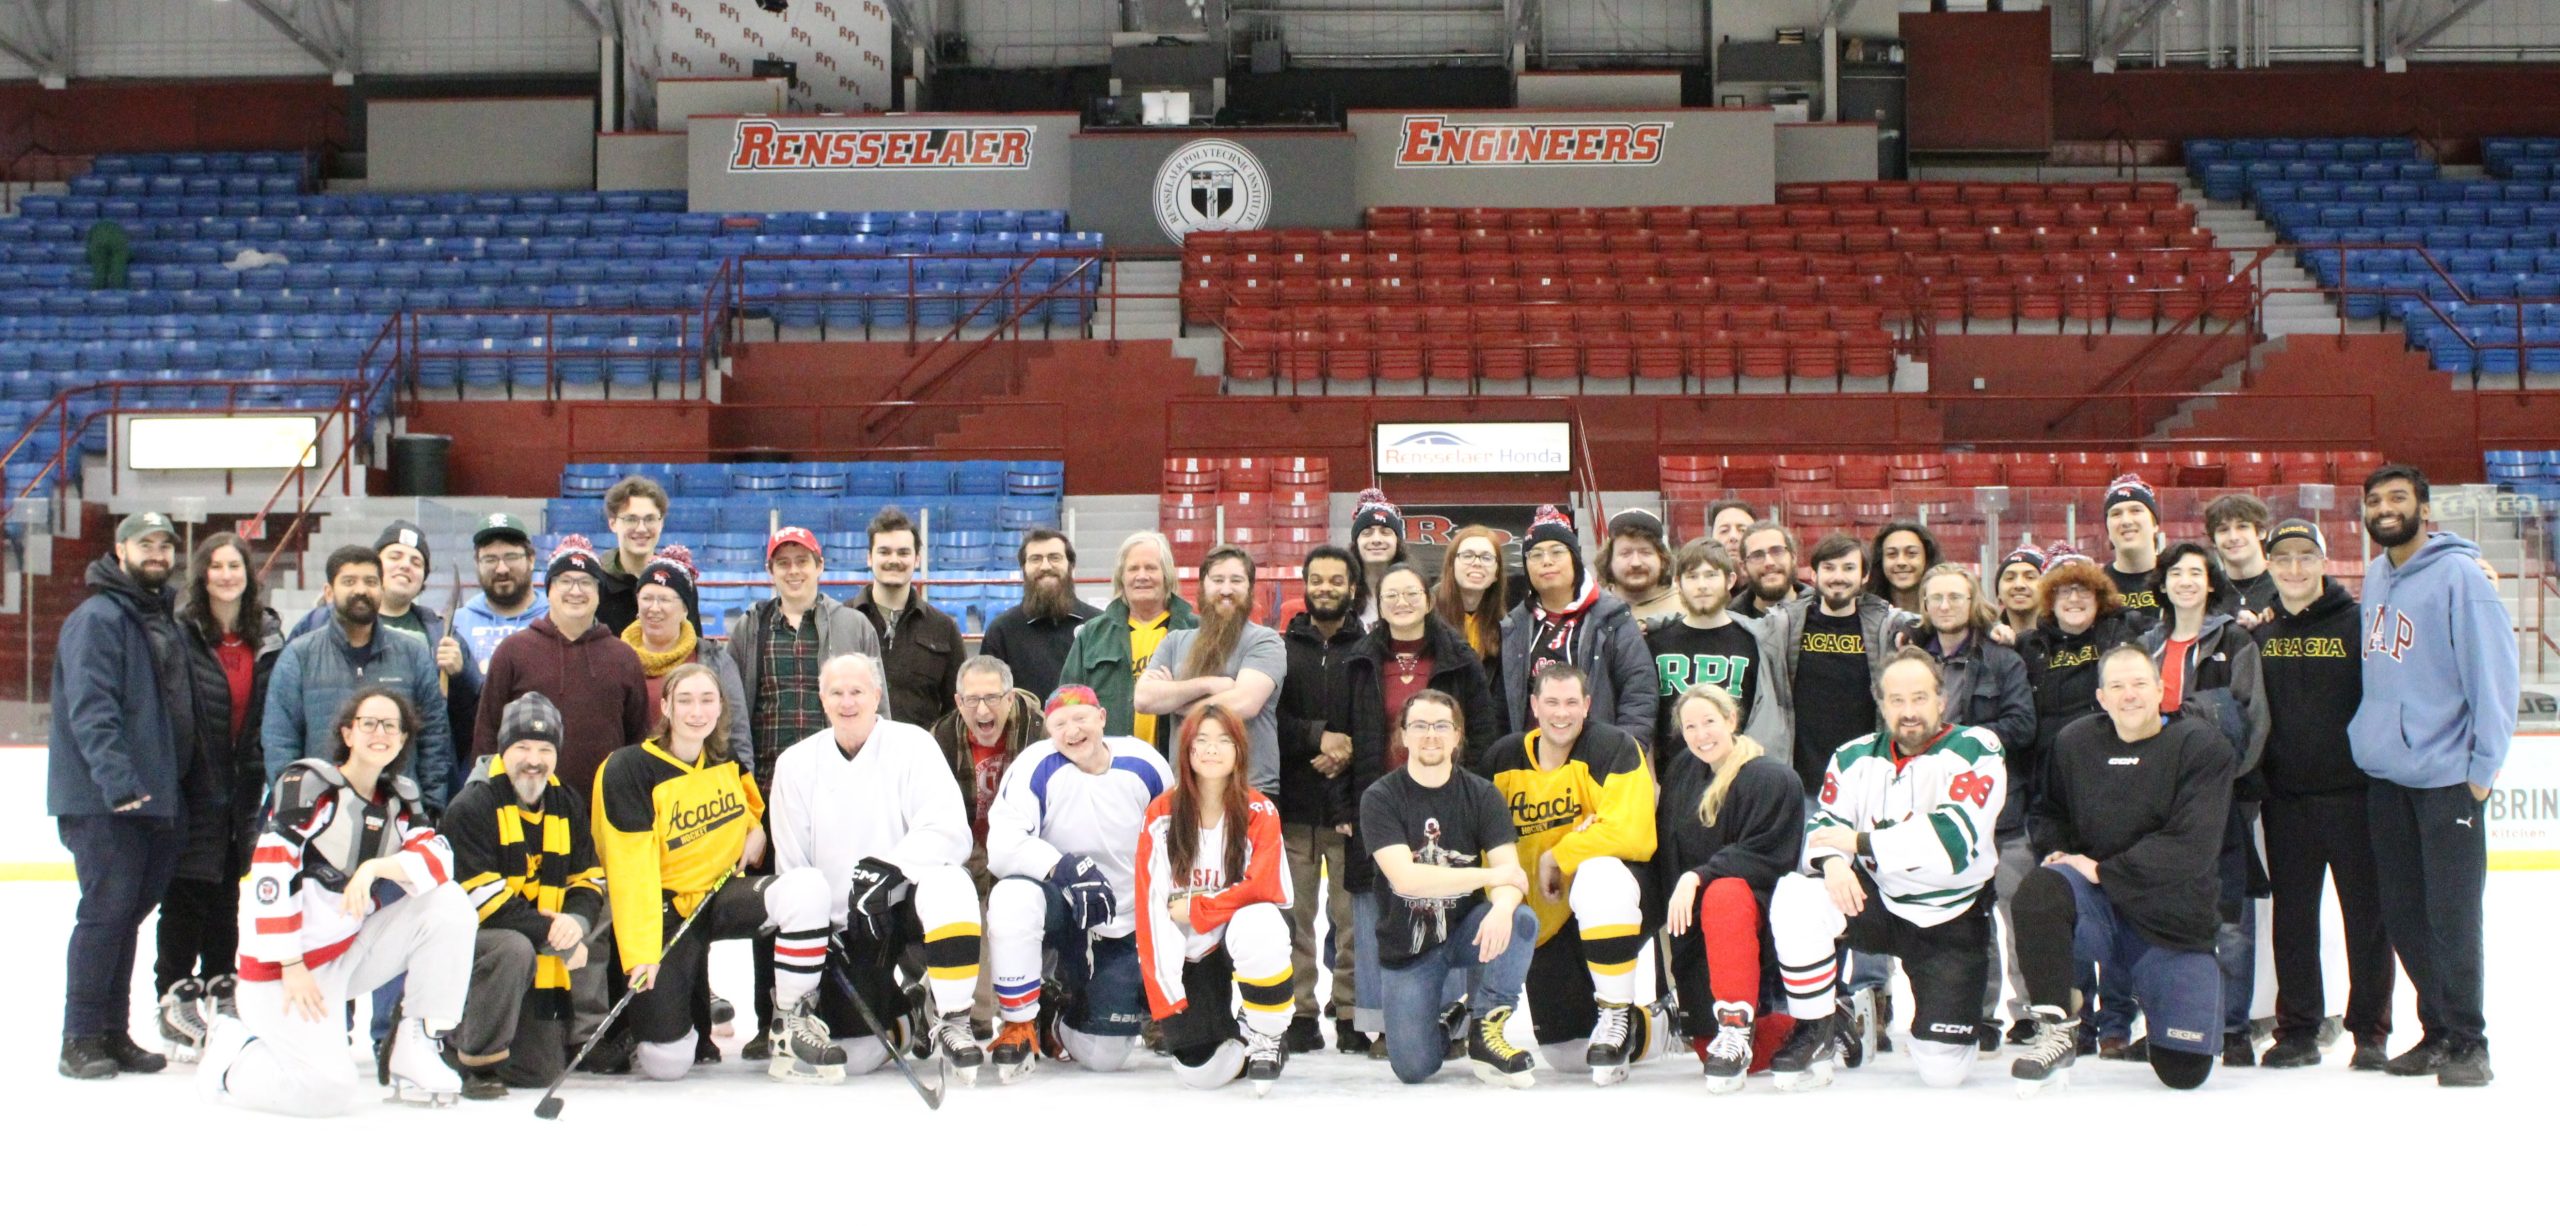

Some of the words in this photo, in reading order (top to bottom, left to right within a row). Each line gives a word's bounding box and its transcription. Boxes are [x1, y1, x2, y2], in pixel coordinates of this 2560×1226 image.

[672, 3, 692, 22] RPI
[720, 3, 740, 22] RPI
[816, 2, 835, 21] RPI
[863, 1, 883, 21] RPI
[695, 28, 715, 48] RPI
[743, 28, 763, 47] RPI
[791, 27, 811, 47] RPI
[840, 26, 859, 46] RPI
[672, 52, 692, 72] RPI
[720, 53, 740, 72] RPI
[816, 52, 836, 71] RPI
[863, 51, 884, 71] RPI
[840, 76, 860, 96] RPI
[731, 121, 1033, 169] RENSSELAER
[1398, 117, 1664, 166] ENGINEERS
[1163, 162, 1186, 224] RENSSELAER
[1182, 148, 1252, 172] POLYTECHNIC
[1245, 172, 1262, 223] INSTITUTE
[1385, 449, 1494, 465] Rensselaer
[1500, 448, 1562, 464] Honda
[1801, 632, 1868, 654] ACACI
[2261, 637, 2347, 658] ACACIA
[1656, 653, 1750, 698] RPI
[1948, 770, 1995, 809] 88
[666, 788, 744, 837] Acacia
[1508, 787, 1578, 823] Acaci
[680, 826, 708, 845] HOCKEY
[1929, 1022, 1975, 1035] CCM
